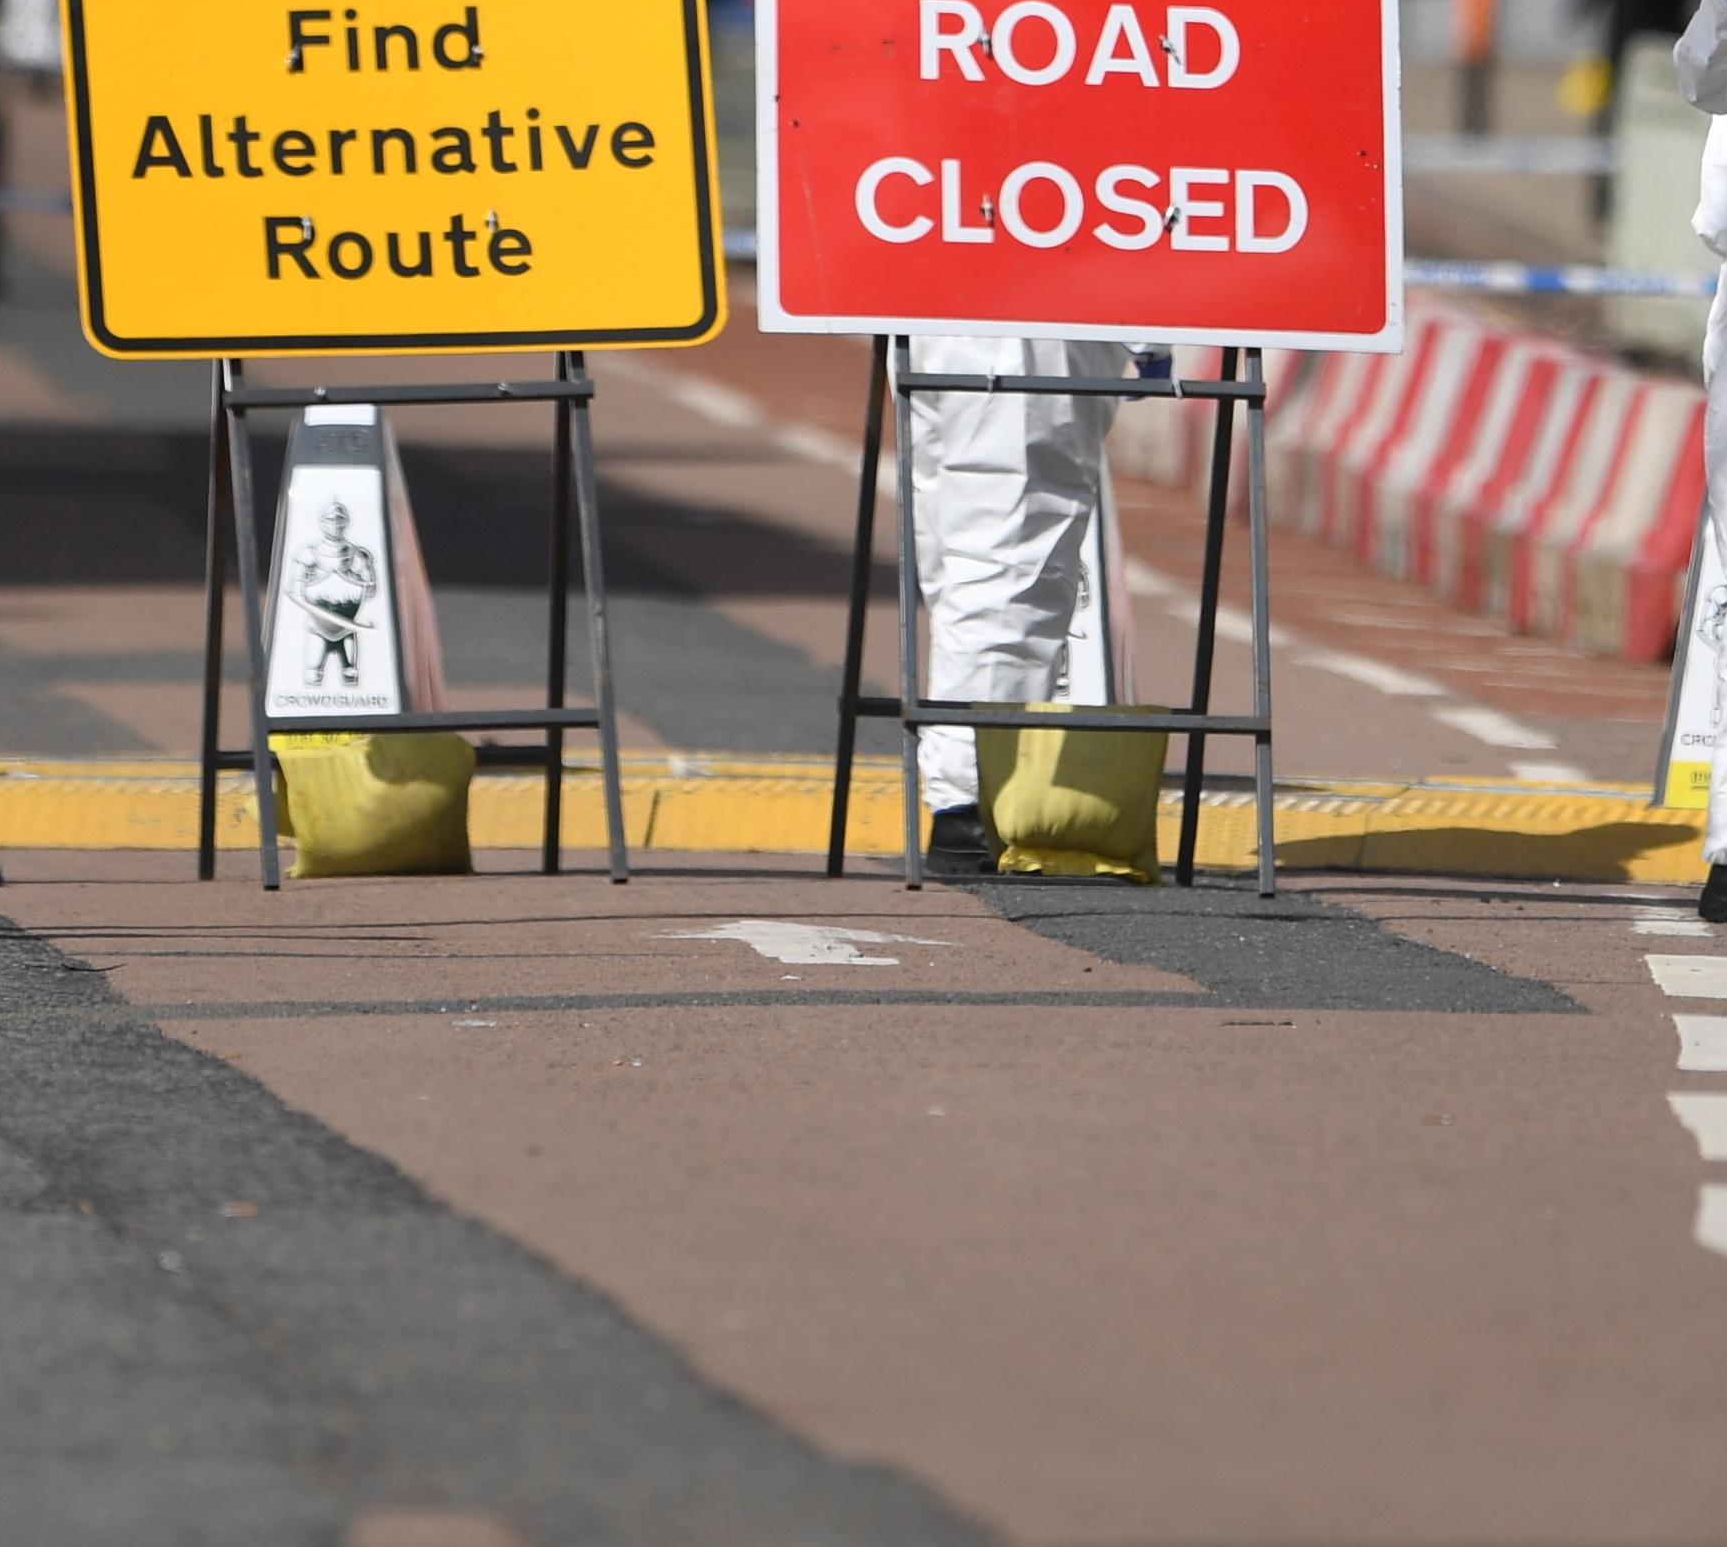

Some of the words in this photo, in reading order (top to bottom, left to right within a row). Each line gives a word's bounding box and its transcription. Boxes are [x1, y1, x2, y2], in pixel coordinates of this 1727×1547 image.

[287, 6, 482, 73] Find
[132, 108, 656, 178] Alternative
[854, 157, 1309, 253] CLOSED
[263, 213, 533, 279] Route
